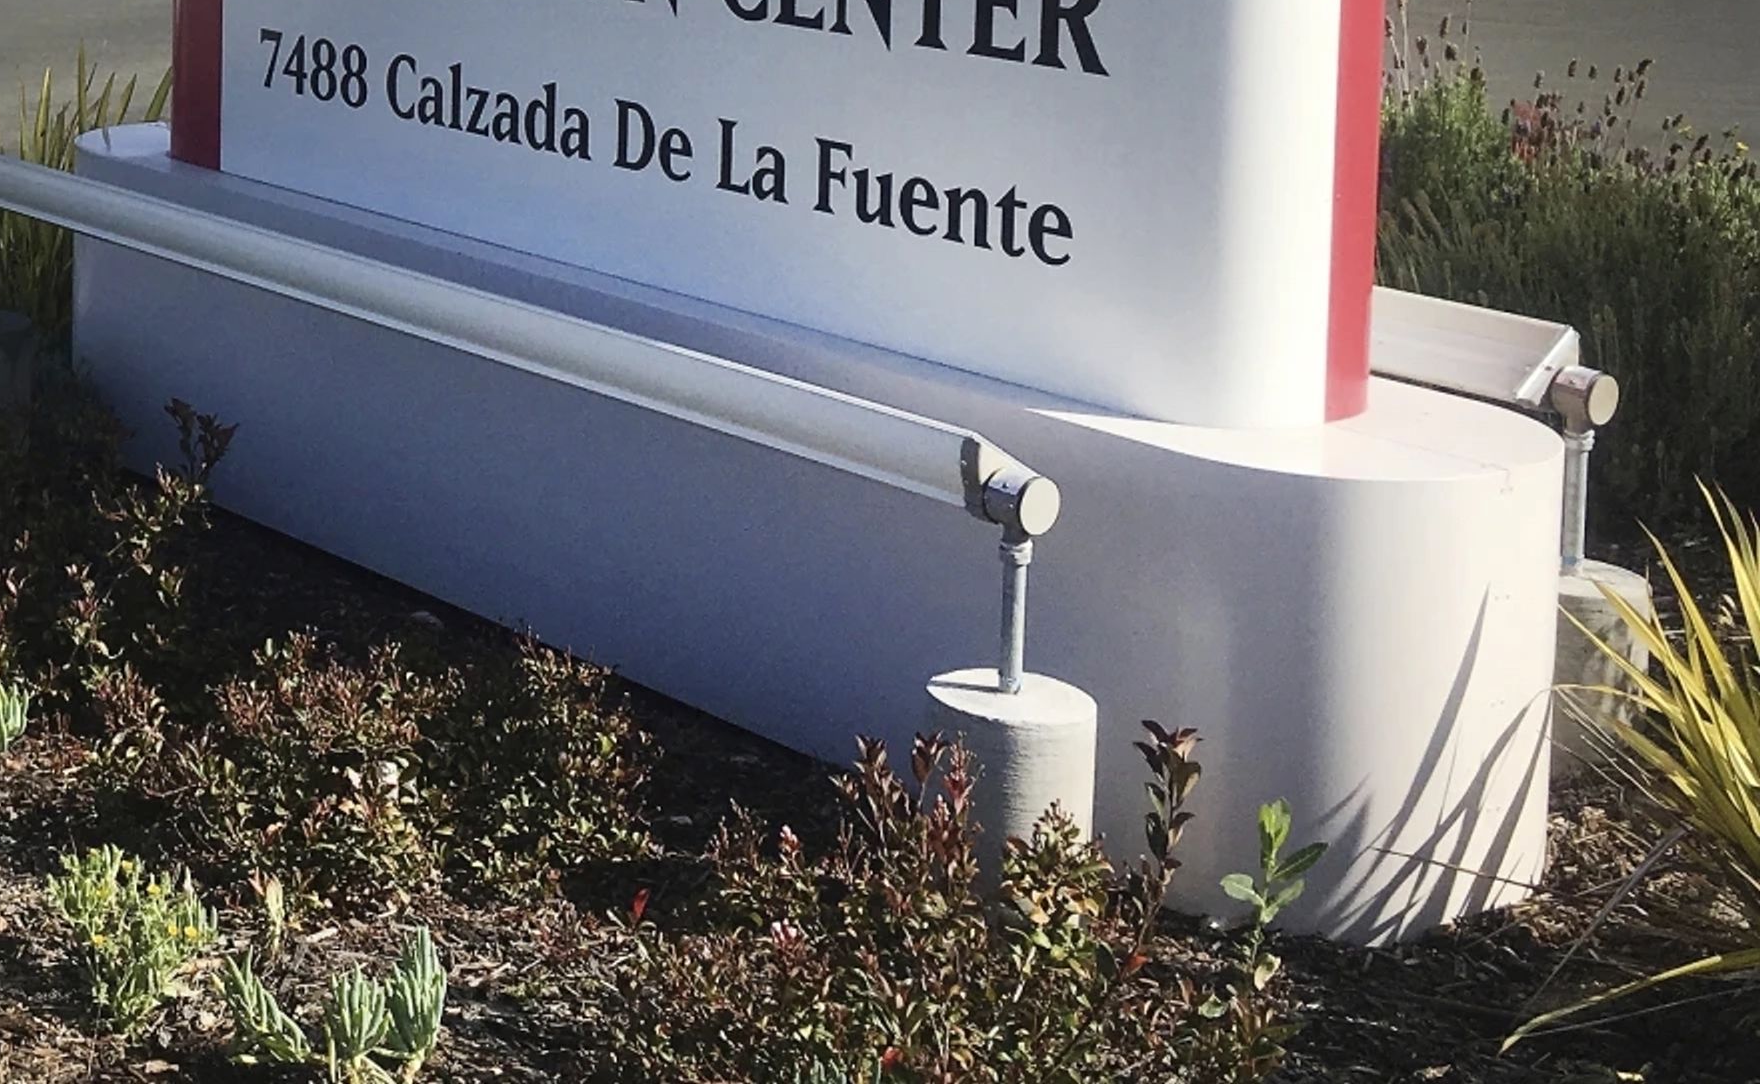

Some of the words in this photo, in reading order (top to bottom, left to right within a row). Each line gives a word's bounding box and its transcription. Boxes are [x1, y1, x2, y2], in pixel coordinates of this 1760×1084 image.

[260, 27, 368, 109] 7488
[386, 53, 592, 162] Calzada
[613, 98, 693, 182] De
[715, 117, 789, 205] La
[812, 137, 1074, 266] Fuente
